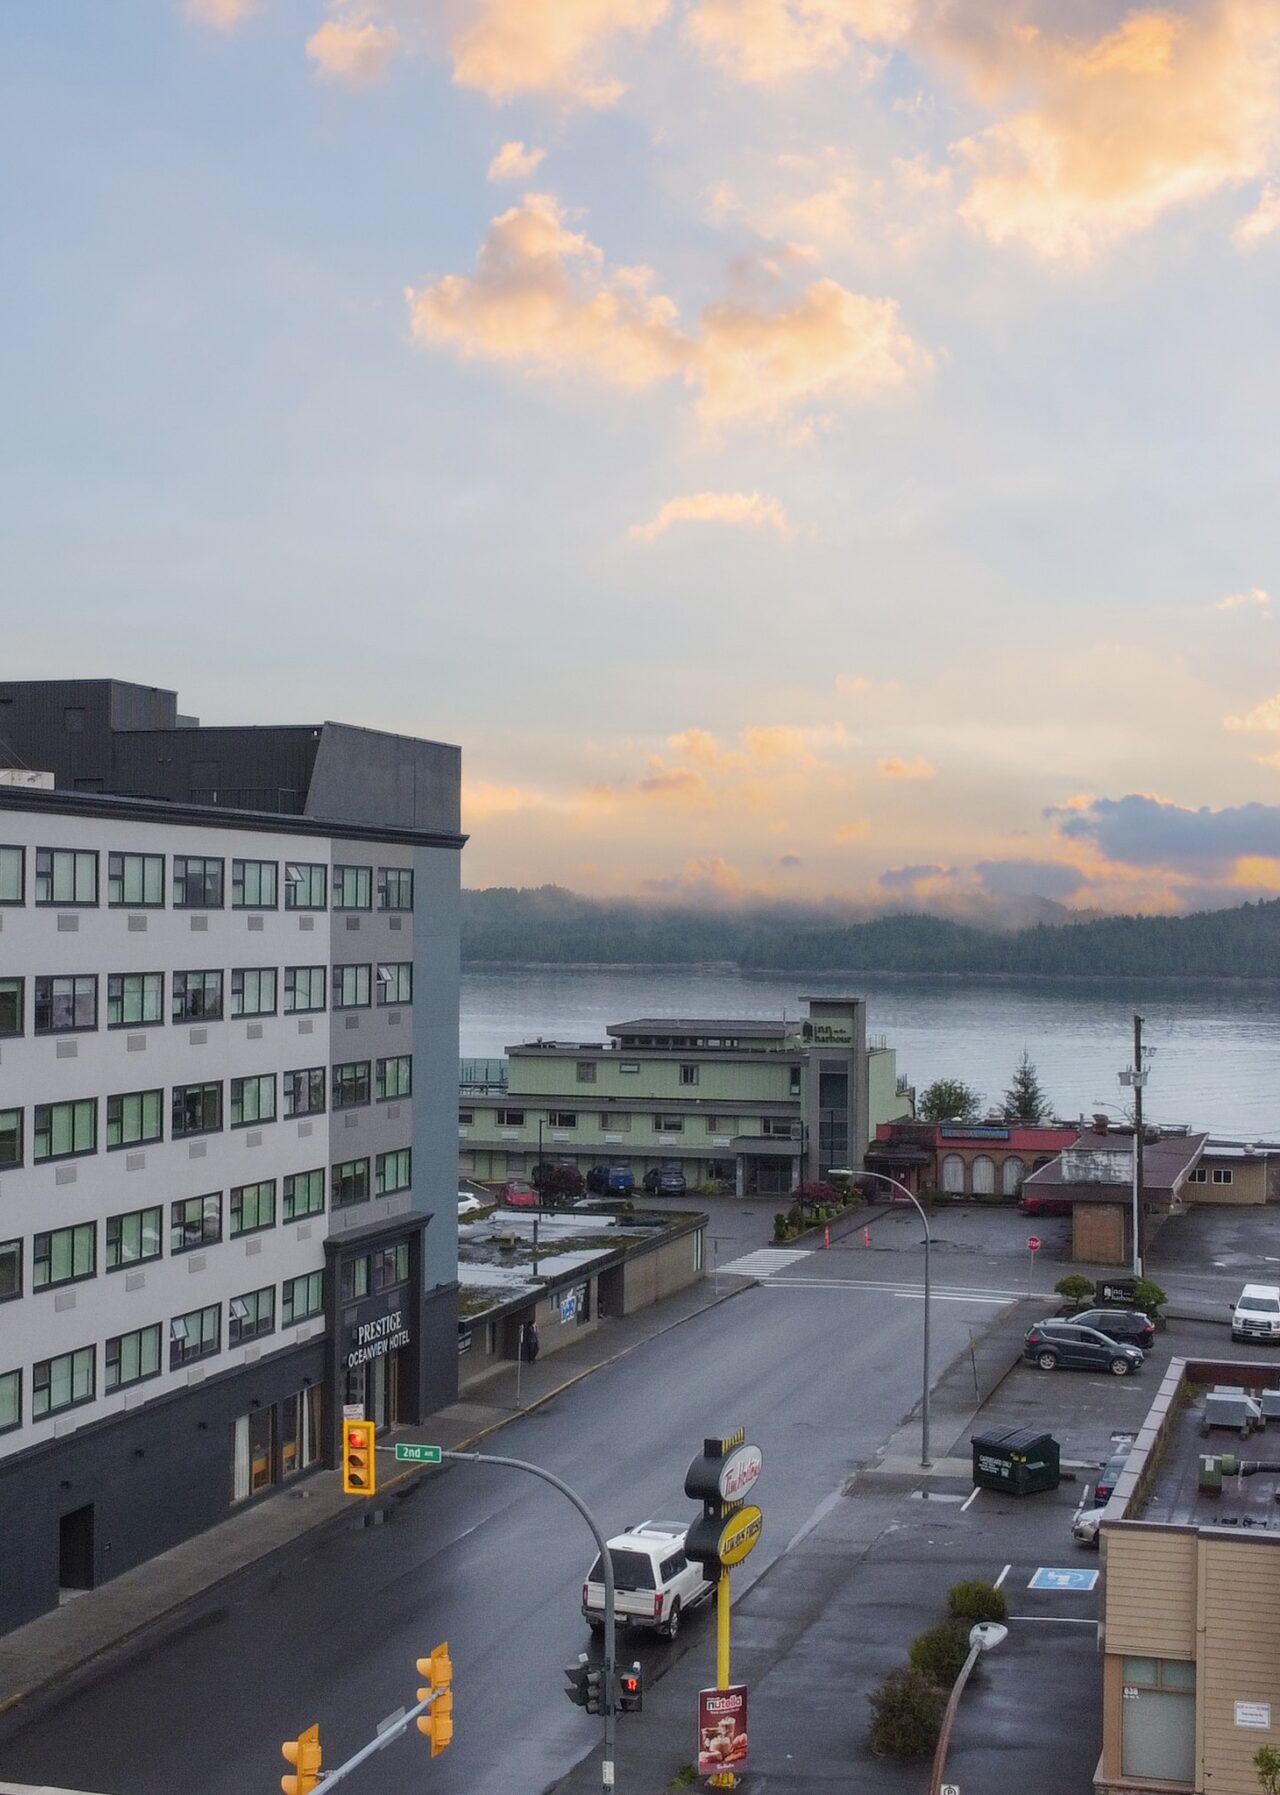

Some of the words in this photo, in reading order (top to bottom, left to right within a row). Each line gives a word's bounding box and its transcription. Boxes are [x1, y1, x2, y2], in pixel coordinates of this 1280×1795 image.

[358, 1311, 402, 1345] PRESTIGE
[348, 1338, 389, 1368] OCEANVIEW
[388, 1330, 410, 1350] HOTEL
[402, 1447, 421, 1458] 2nd
[708, 1695, 742, 1709] nutella
